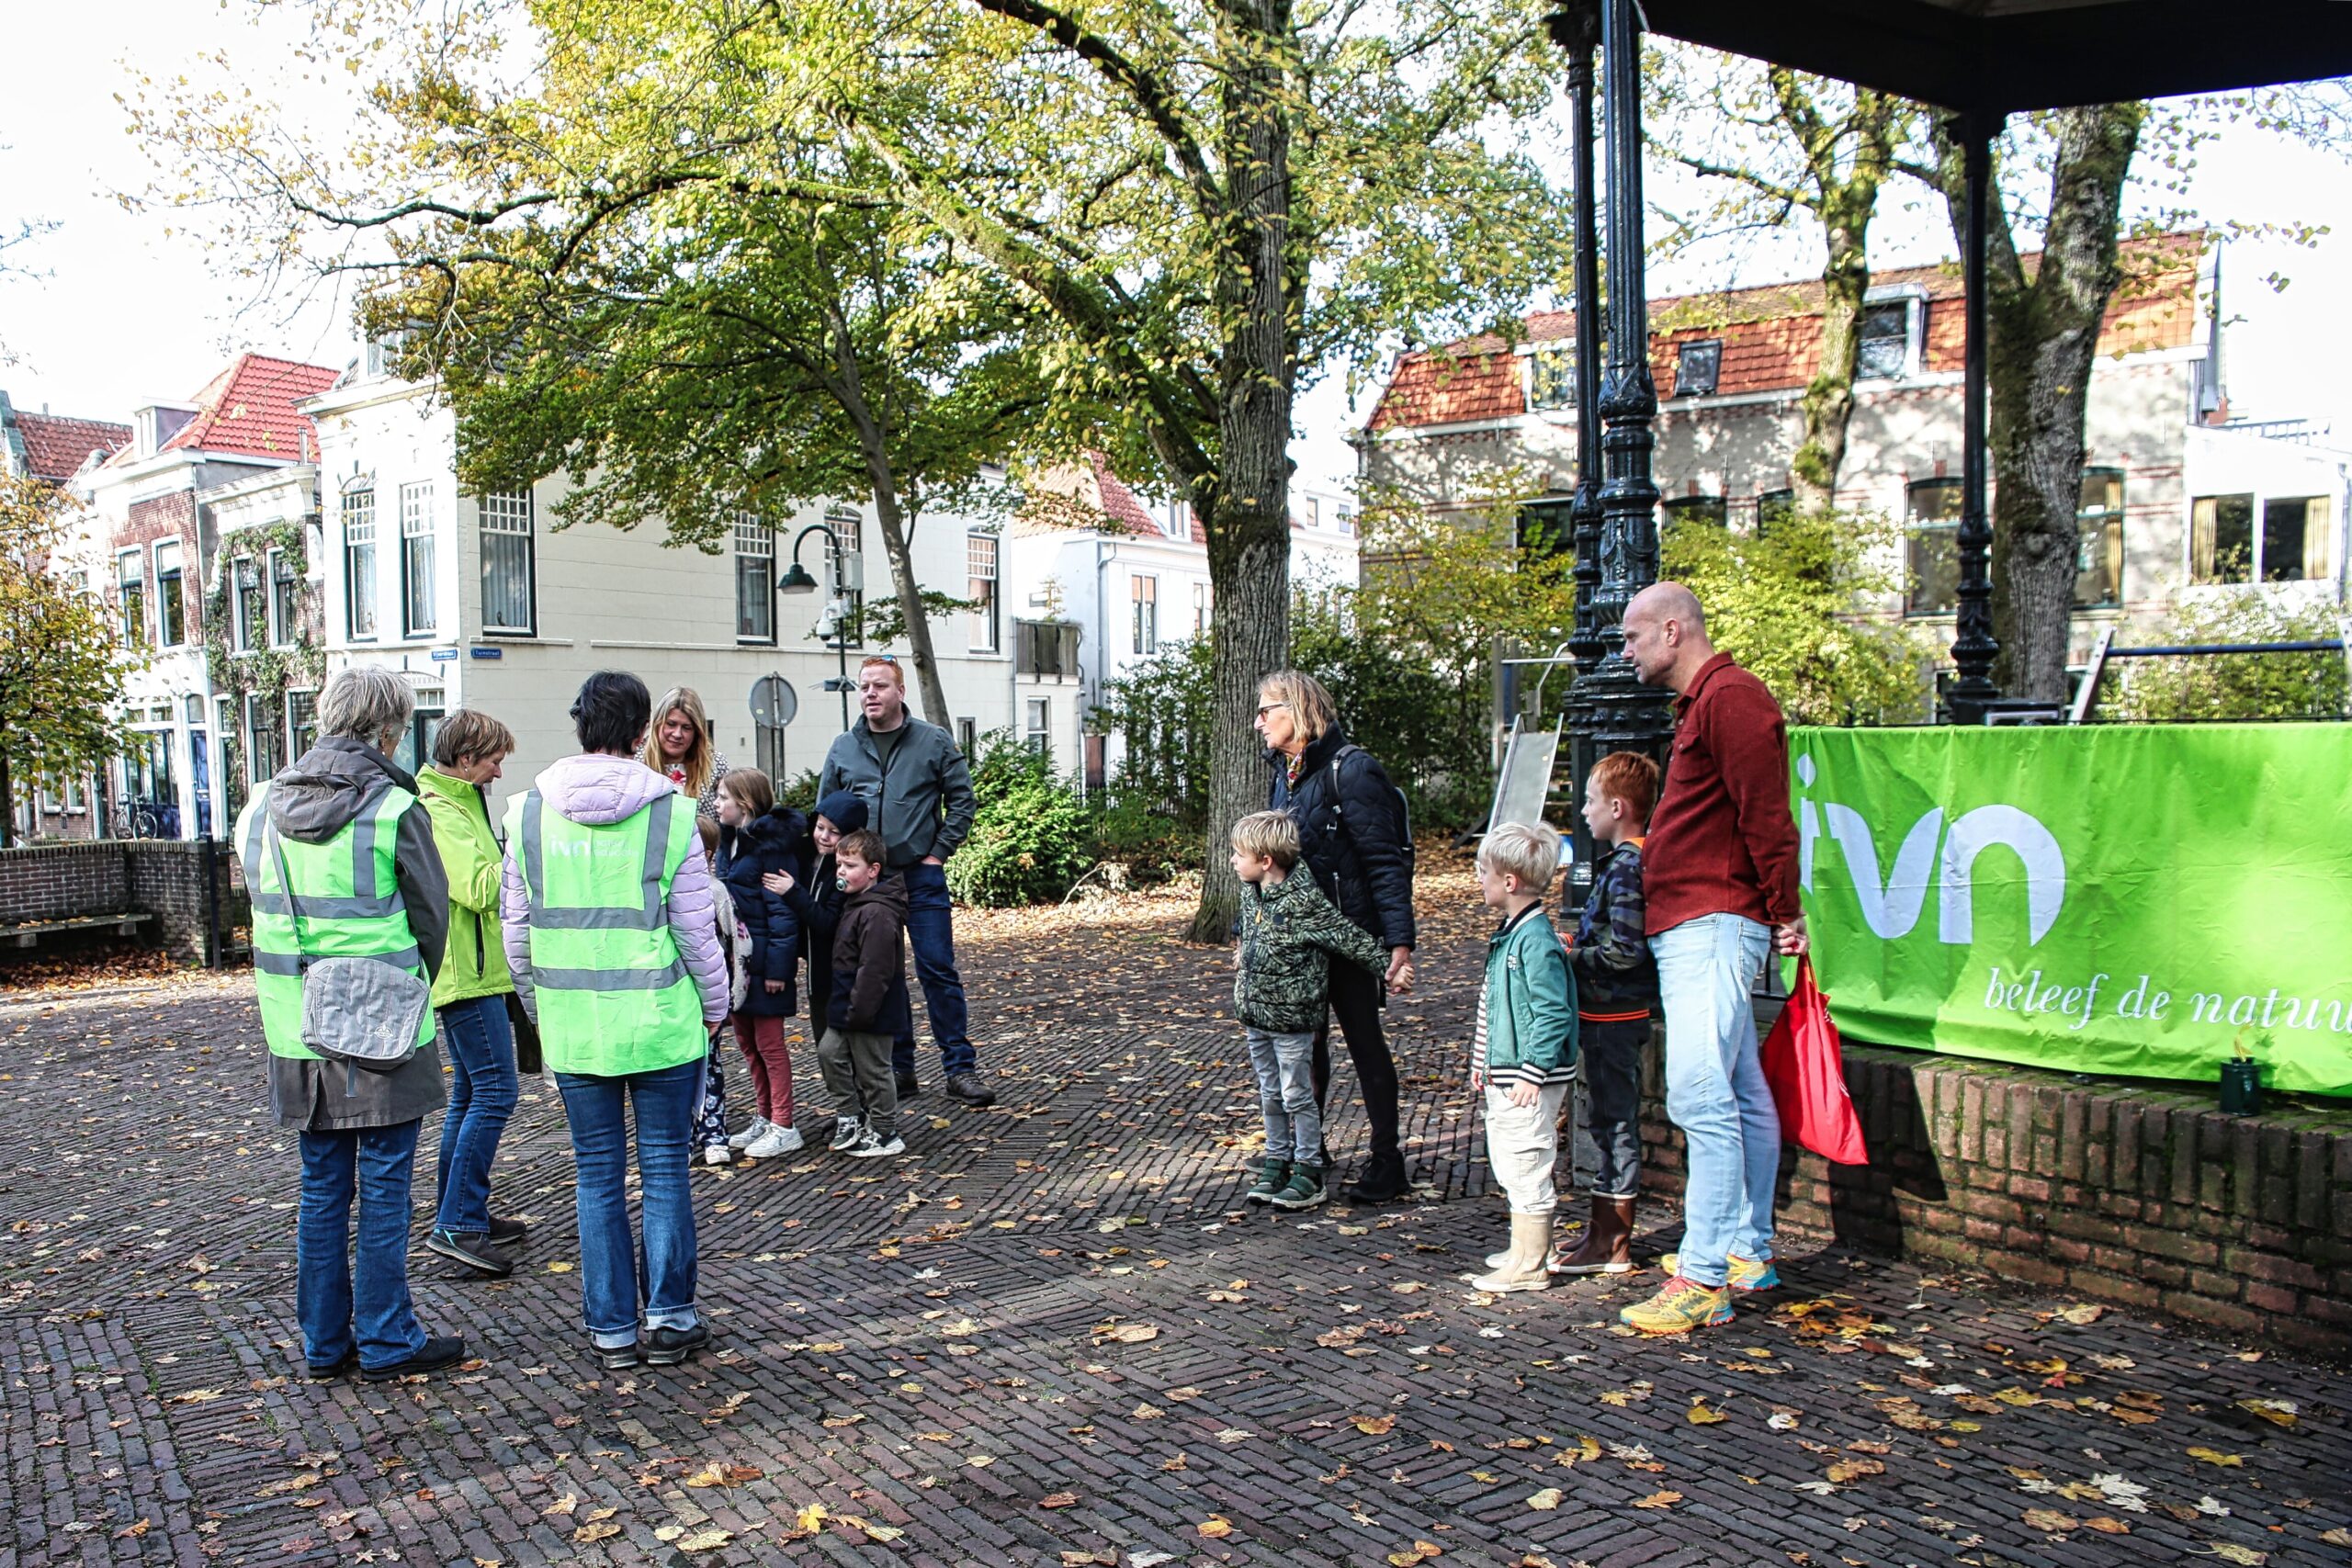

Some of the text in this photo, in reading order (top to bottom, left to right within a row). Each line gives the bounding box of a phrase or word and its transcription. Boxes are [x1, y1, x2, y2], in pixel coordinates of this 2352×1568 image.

[549, 834, 590, 857] ivn
[1797, 752, 2066, 947] ivn
[1984, 967, 2109, 1031] beleef
[2118, 975, 2170, 1021] de
